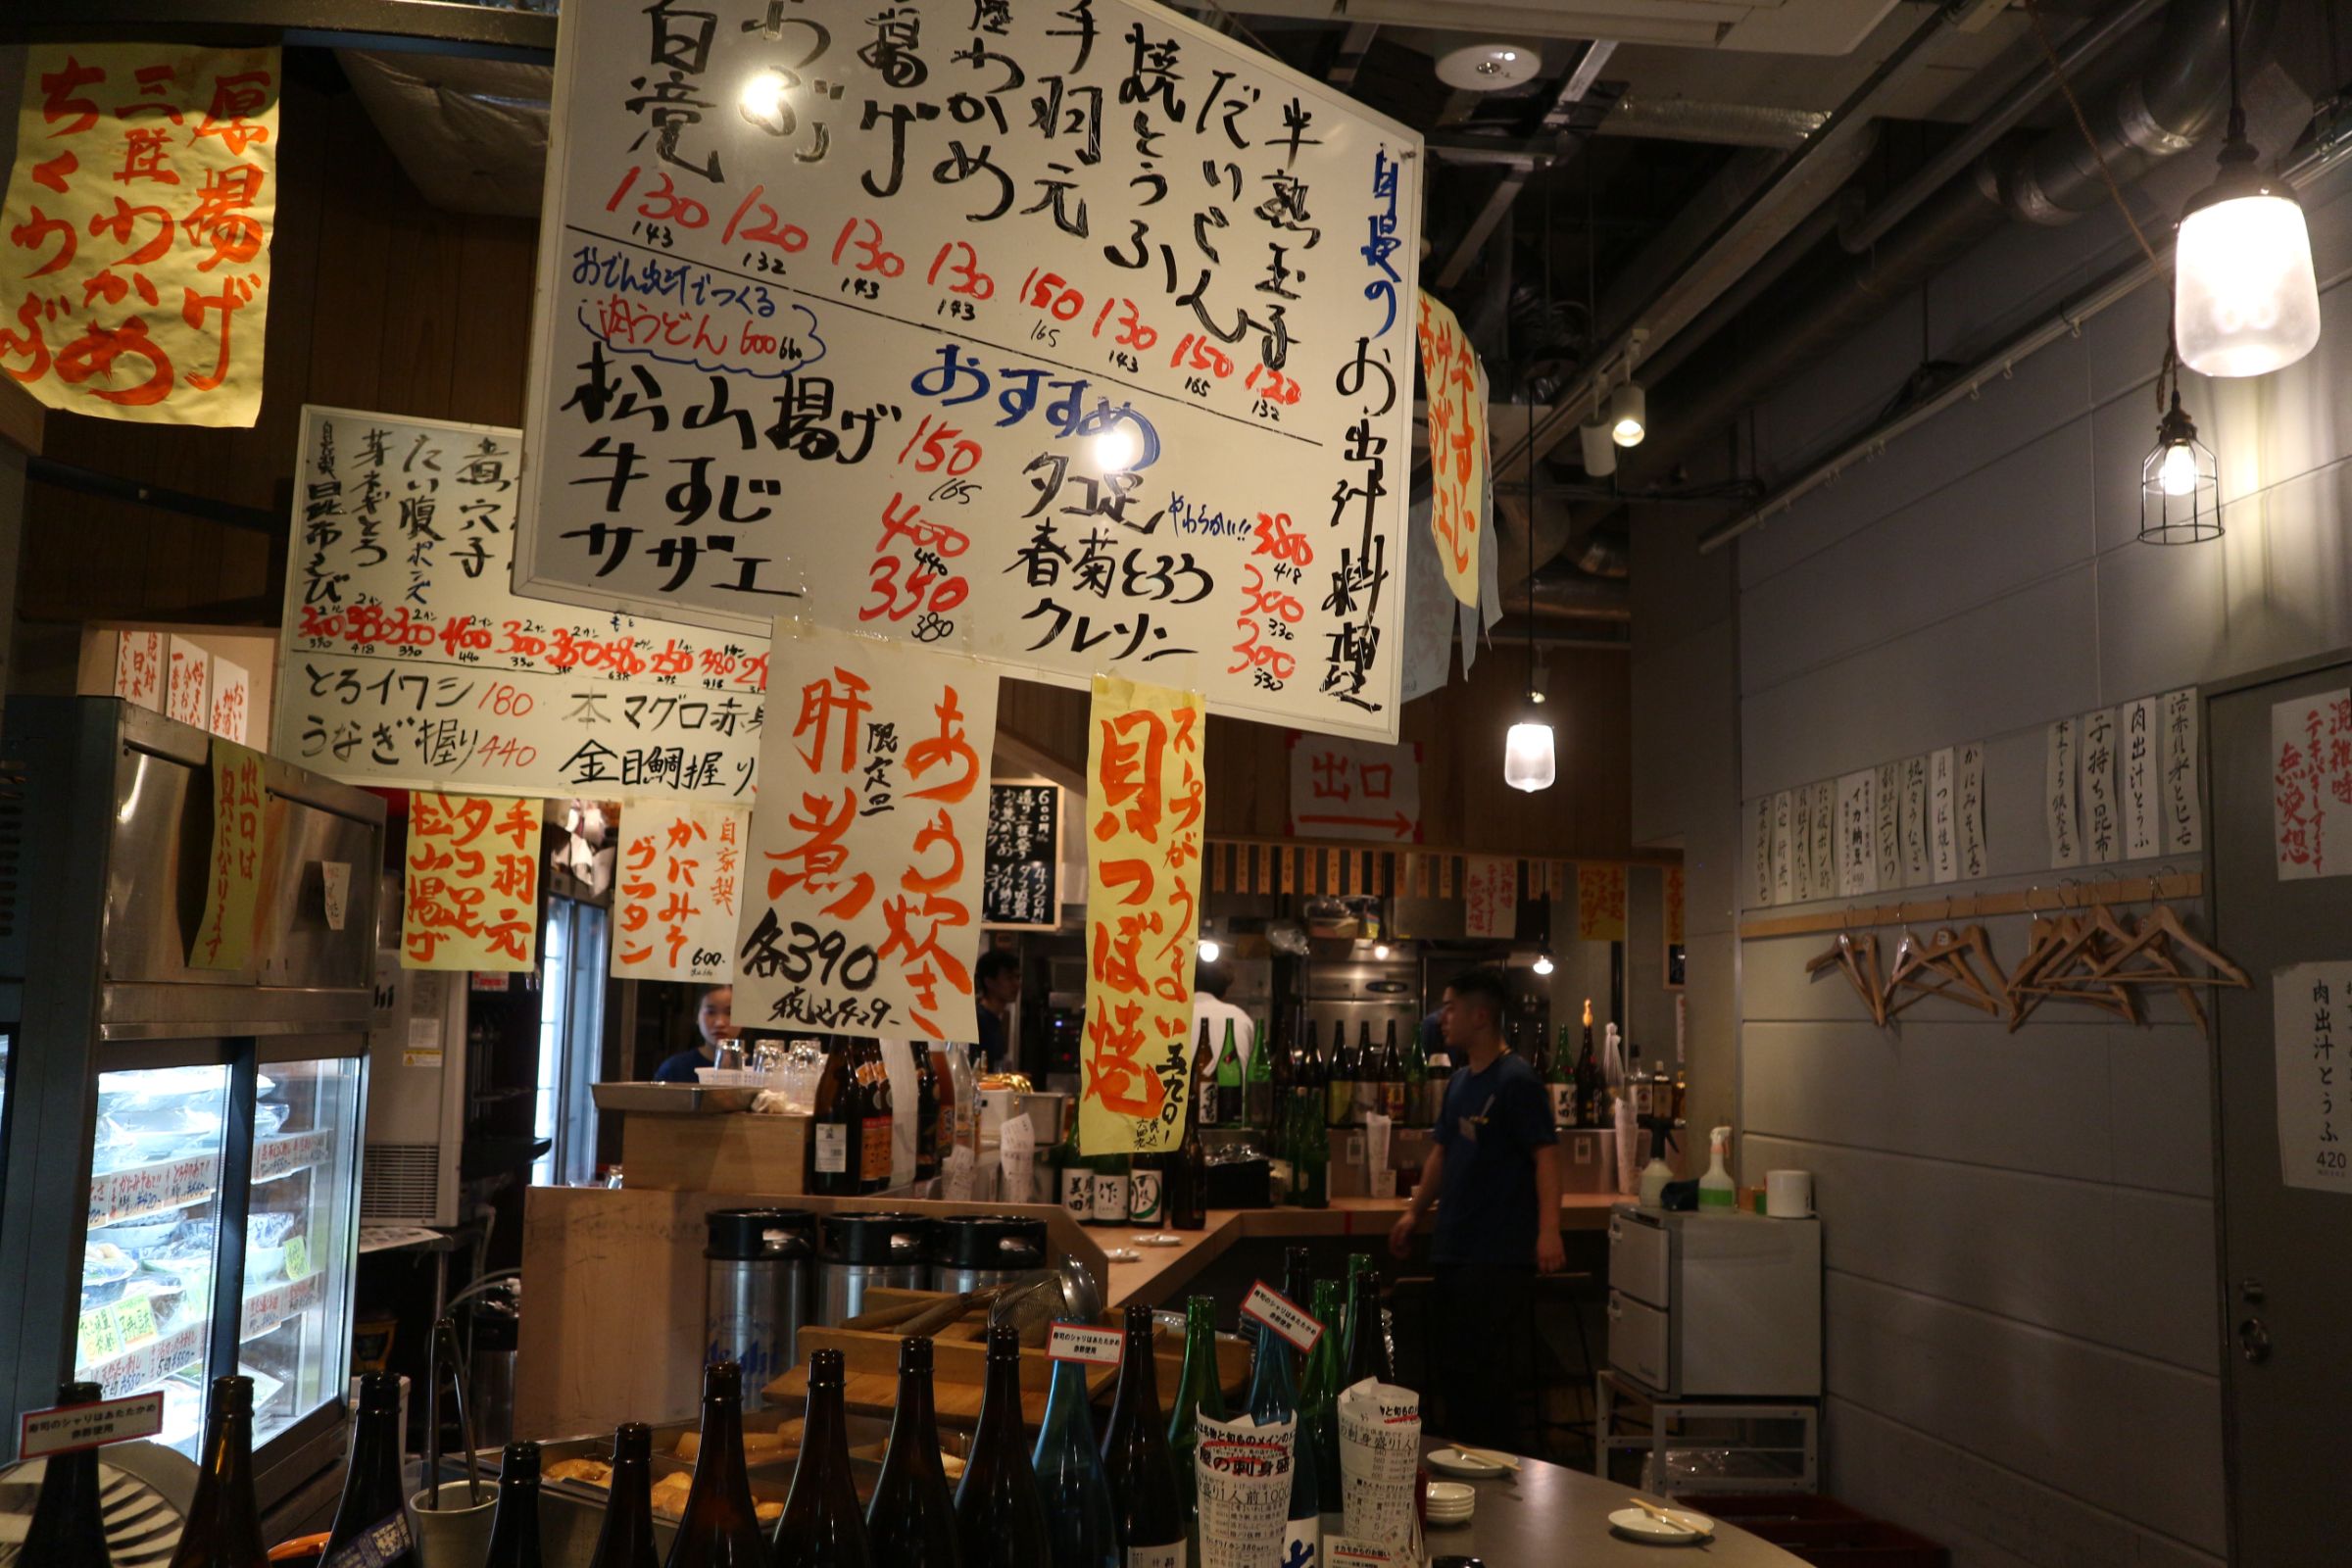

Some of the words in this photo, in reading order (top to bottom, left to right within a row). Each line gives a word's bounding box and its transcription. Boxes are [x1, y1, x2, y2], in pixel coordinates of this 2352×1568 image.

[1019, 0, 1102, 238] 手羽元
[1103, 23, 1185, 294] 焼とうふ
[0, 56, 107, 383] ちくわぶ
[607, 167, 710, 220] 130
[721, 185, 808, 253] 120
[54, 65, 183, 407] 三陸わかめ
[181, 69, 272, 393] 厚揚げ
[632, 221, 674, 248] 143
[832, 218, 905, 278] 130
[1255, 98, 1322, 369] 半熟玉子
[743, 251, 786, 275] 132
[841, 277, 880, 300] 143
[927, 241, 995, 301] 130
[938, 300, 976, 321] 143
[1020, 267, 1084, 321] 150
[1092, 297, 1157, 350] 130
[740, 319, 776, 355] 600
[1030, 319, 1060, 348] 165
[1108, 349, 1139, 373] 143
[1171, 332, 1235, 378] 150
[561, 341, 902, 465] 松山揚げ
[911, 344, 1160, 472] おすすめ
[1184, 375, 1211, 398] 165
[1245, 365, 1301, 405] 120
[1251, 399, 1280, 421] 132
[898, 414, 983, 476] 150
[449, 437, 512, 578] 煮穴子
[568, 436, 782, 526] 牛すじ
[875, 491, 970, 558] 400
[1251, 513, 1314, 566] 380
[560, 523, 804, 599] サザエ
[859, 555, 970, 621] 350
[913, 547, 948, 576] 440
[1274, 563, 1302, 585] 418
[1240, 564, 1304, 623] 300
[699, 649, 736, 676] 380
[1227, 619, 1296, 679] 300
[305, 663, 474, 710] とろイワシ
[478, 680, 534, 716] 180
[302, 714, 479, 774] うなぎ握り
[476, 735, 537, 767] 440
[559, 739, 755, 797] 金目鯛握り
[763, 665, 875, 921] 肝煮
[1311, 751, 1393, 802] 出口
[2131, 703, 2149, 849] 肉出汁とうふ
[483, 799, 538, 962] 手羽元
[659, 817, 707, 968] かにみそ
[710, 816, 738, 915] 自家製
[1155, 706, 1204, 1039] スープがうまい
[619, 835, 657, 965] グラタン
[740, 906, 880, 993] 各390
[2313, 978, 2339, 1143] 肉出汁とうふ
[2316, 1151, 2347, 1169] 420
